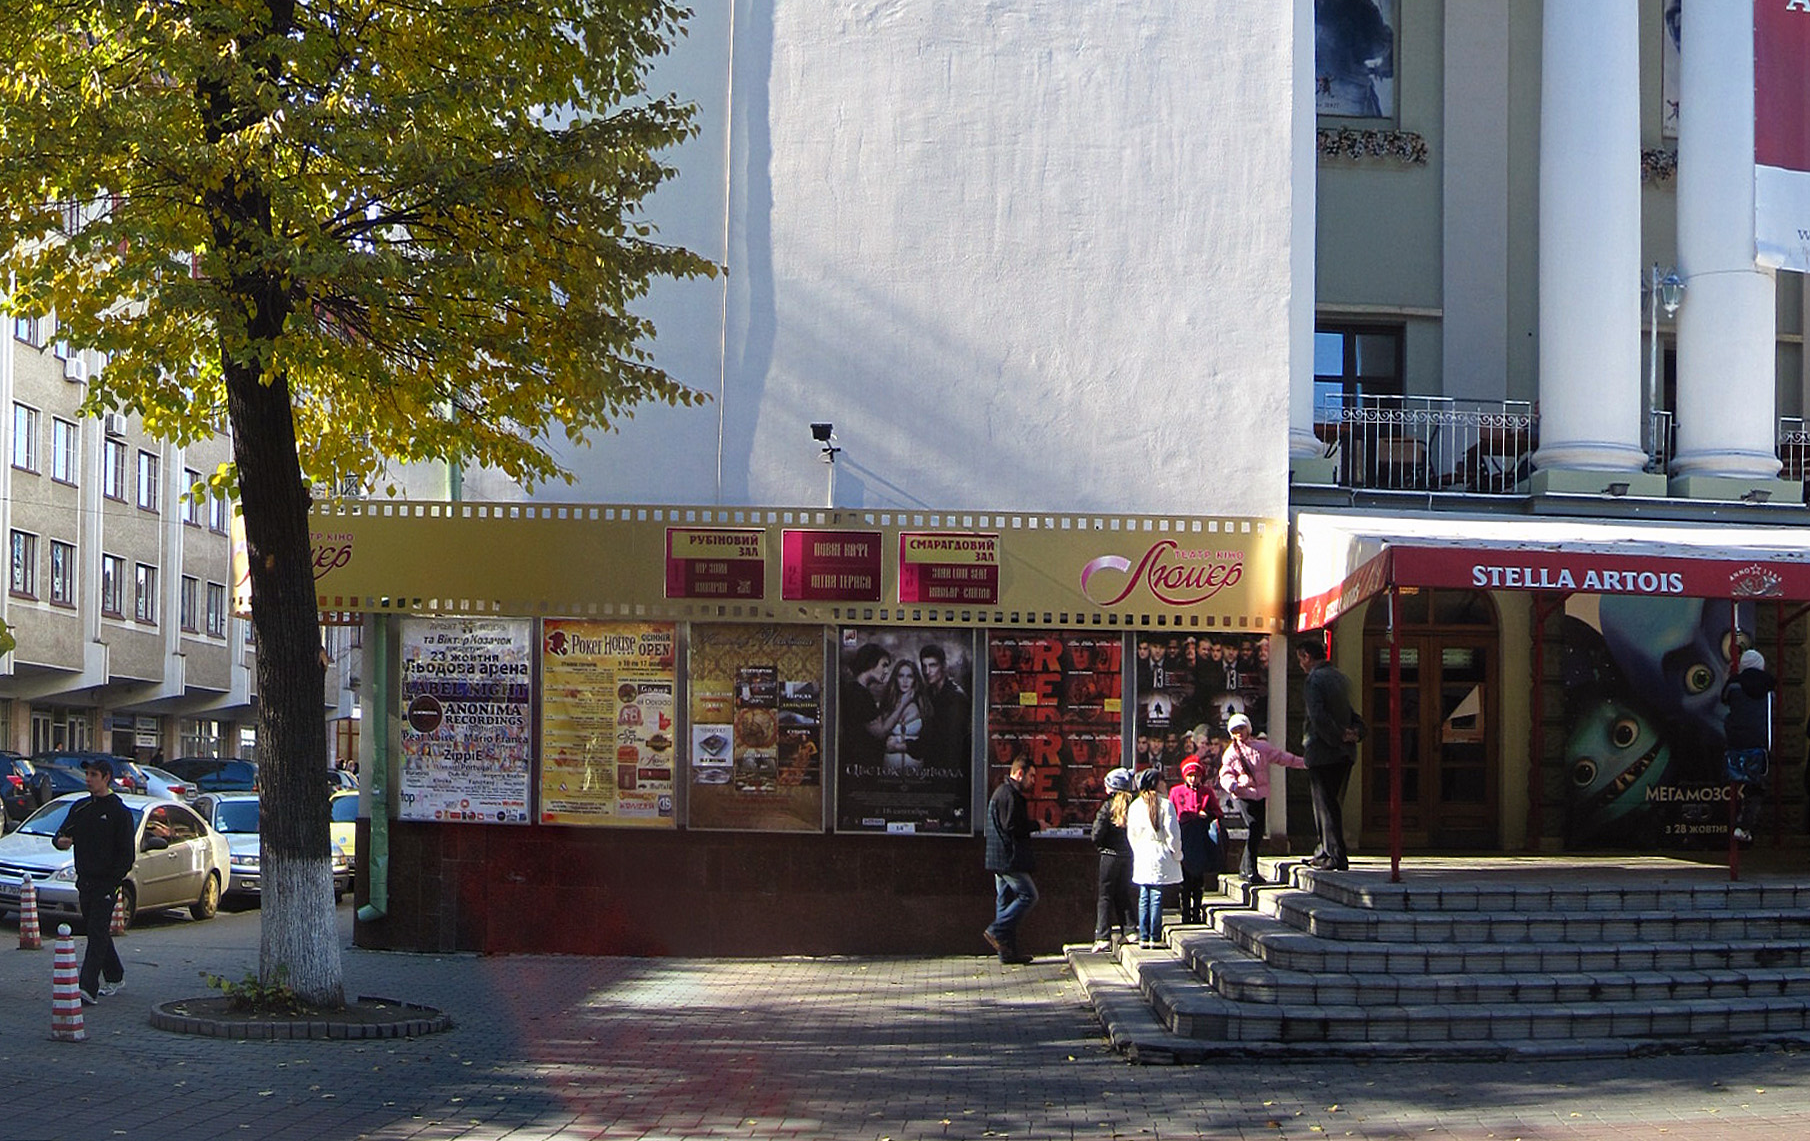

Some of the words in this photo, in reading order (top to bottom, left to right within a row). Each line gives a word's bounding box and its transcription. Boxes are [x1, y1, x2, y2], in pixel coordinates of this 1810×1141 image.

[690, 535, 758, 546] РУБІНОВИЙ
[910, 539, 995, 551] СМАРАГДОВИЙ
[739, 547, 758, 557] ЗАЛ
[975, 552, 994, 562] ЗАЛ
[1175, 550, 1211, 559] ТЕАТР
[1216, 551, 1244, 559] КІНО
[1472, 565, 1576, 590] STELLA
[1583, 570, 1684, 594] ARTOIS
[424, 636, 435, 644] та
[641, 634, 671, 642] ОСІННІЙ
[638, 643, 670, 656] OPEN
[430, 651, 446, 662] 23
[450, 654, 499, 662] жовтня
[480, 663, 528, 677] арена
[1153, 668, 1163, 688] 13
[1226, 669, 1237, 690] 13
[406, 682, 462, 696] LABEL
[469, 684, 526, 697] NIGHT
[445, 703, 521, 716] ANONIMA
[445, 715, 523, 725] RECORDINGS
[444, 749, 482, 763] ZippiE
[1674, 824, 1686, 834] 28
[1689, 825, 1728, 834] жовтня
